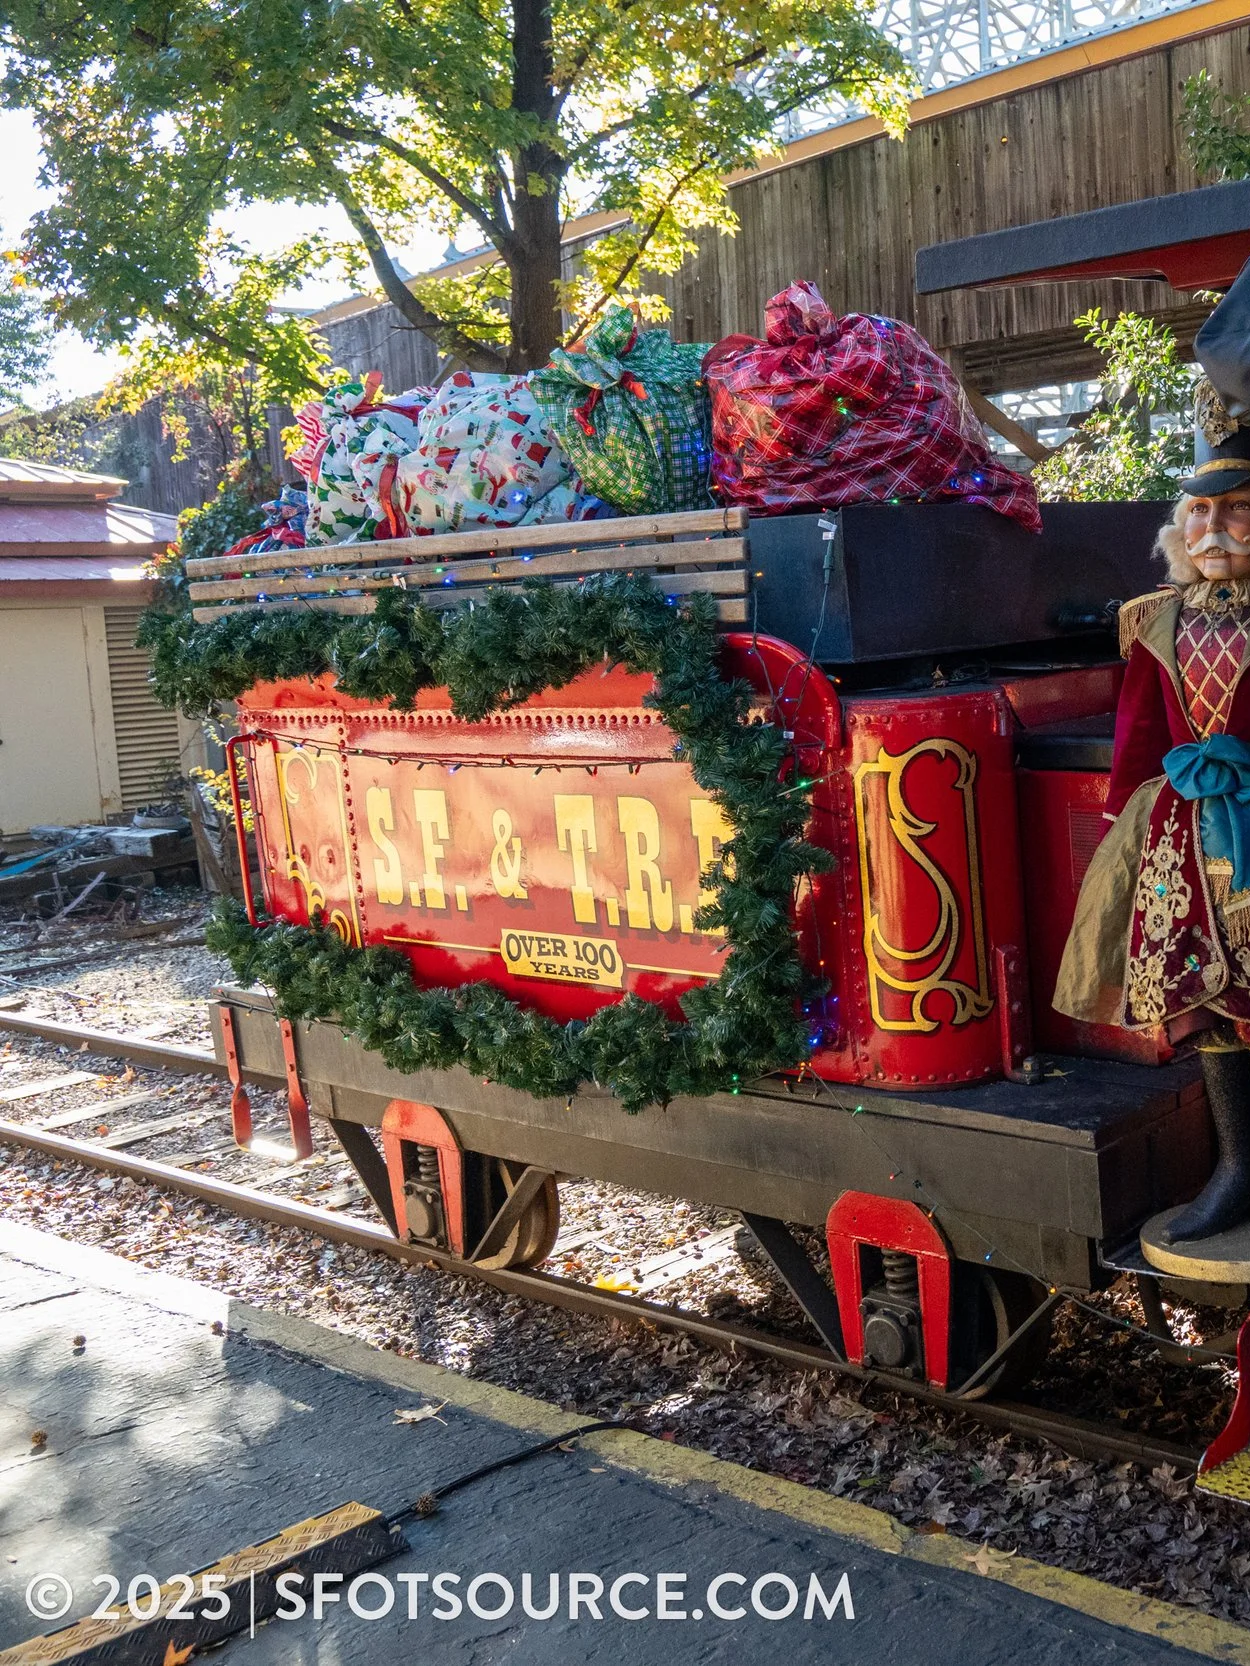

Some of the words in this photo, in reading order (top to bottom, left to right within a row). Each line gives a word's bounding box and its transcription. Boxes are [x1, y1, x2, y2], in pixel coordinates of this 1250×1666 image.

[366, 786, 469, 911] S.F.
[490, 808, 529, 899] &
[505, 933, 568, 962] OVER
[573, 940, 617, 974] 100
[530, 961, 600, 981] YEARS
